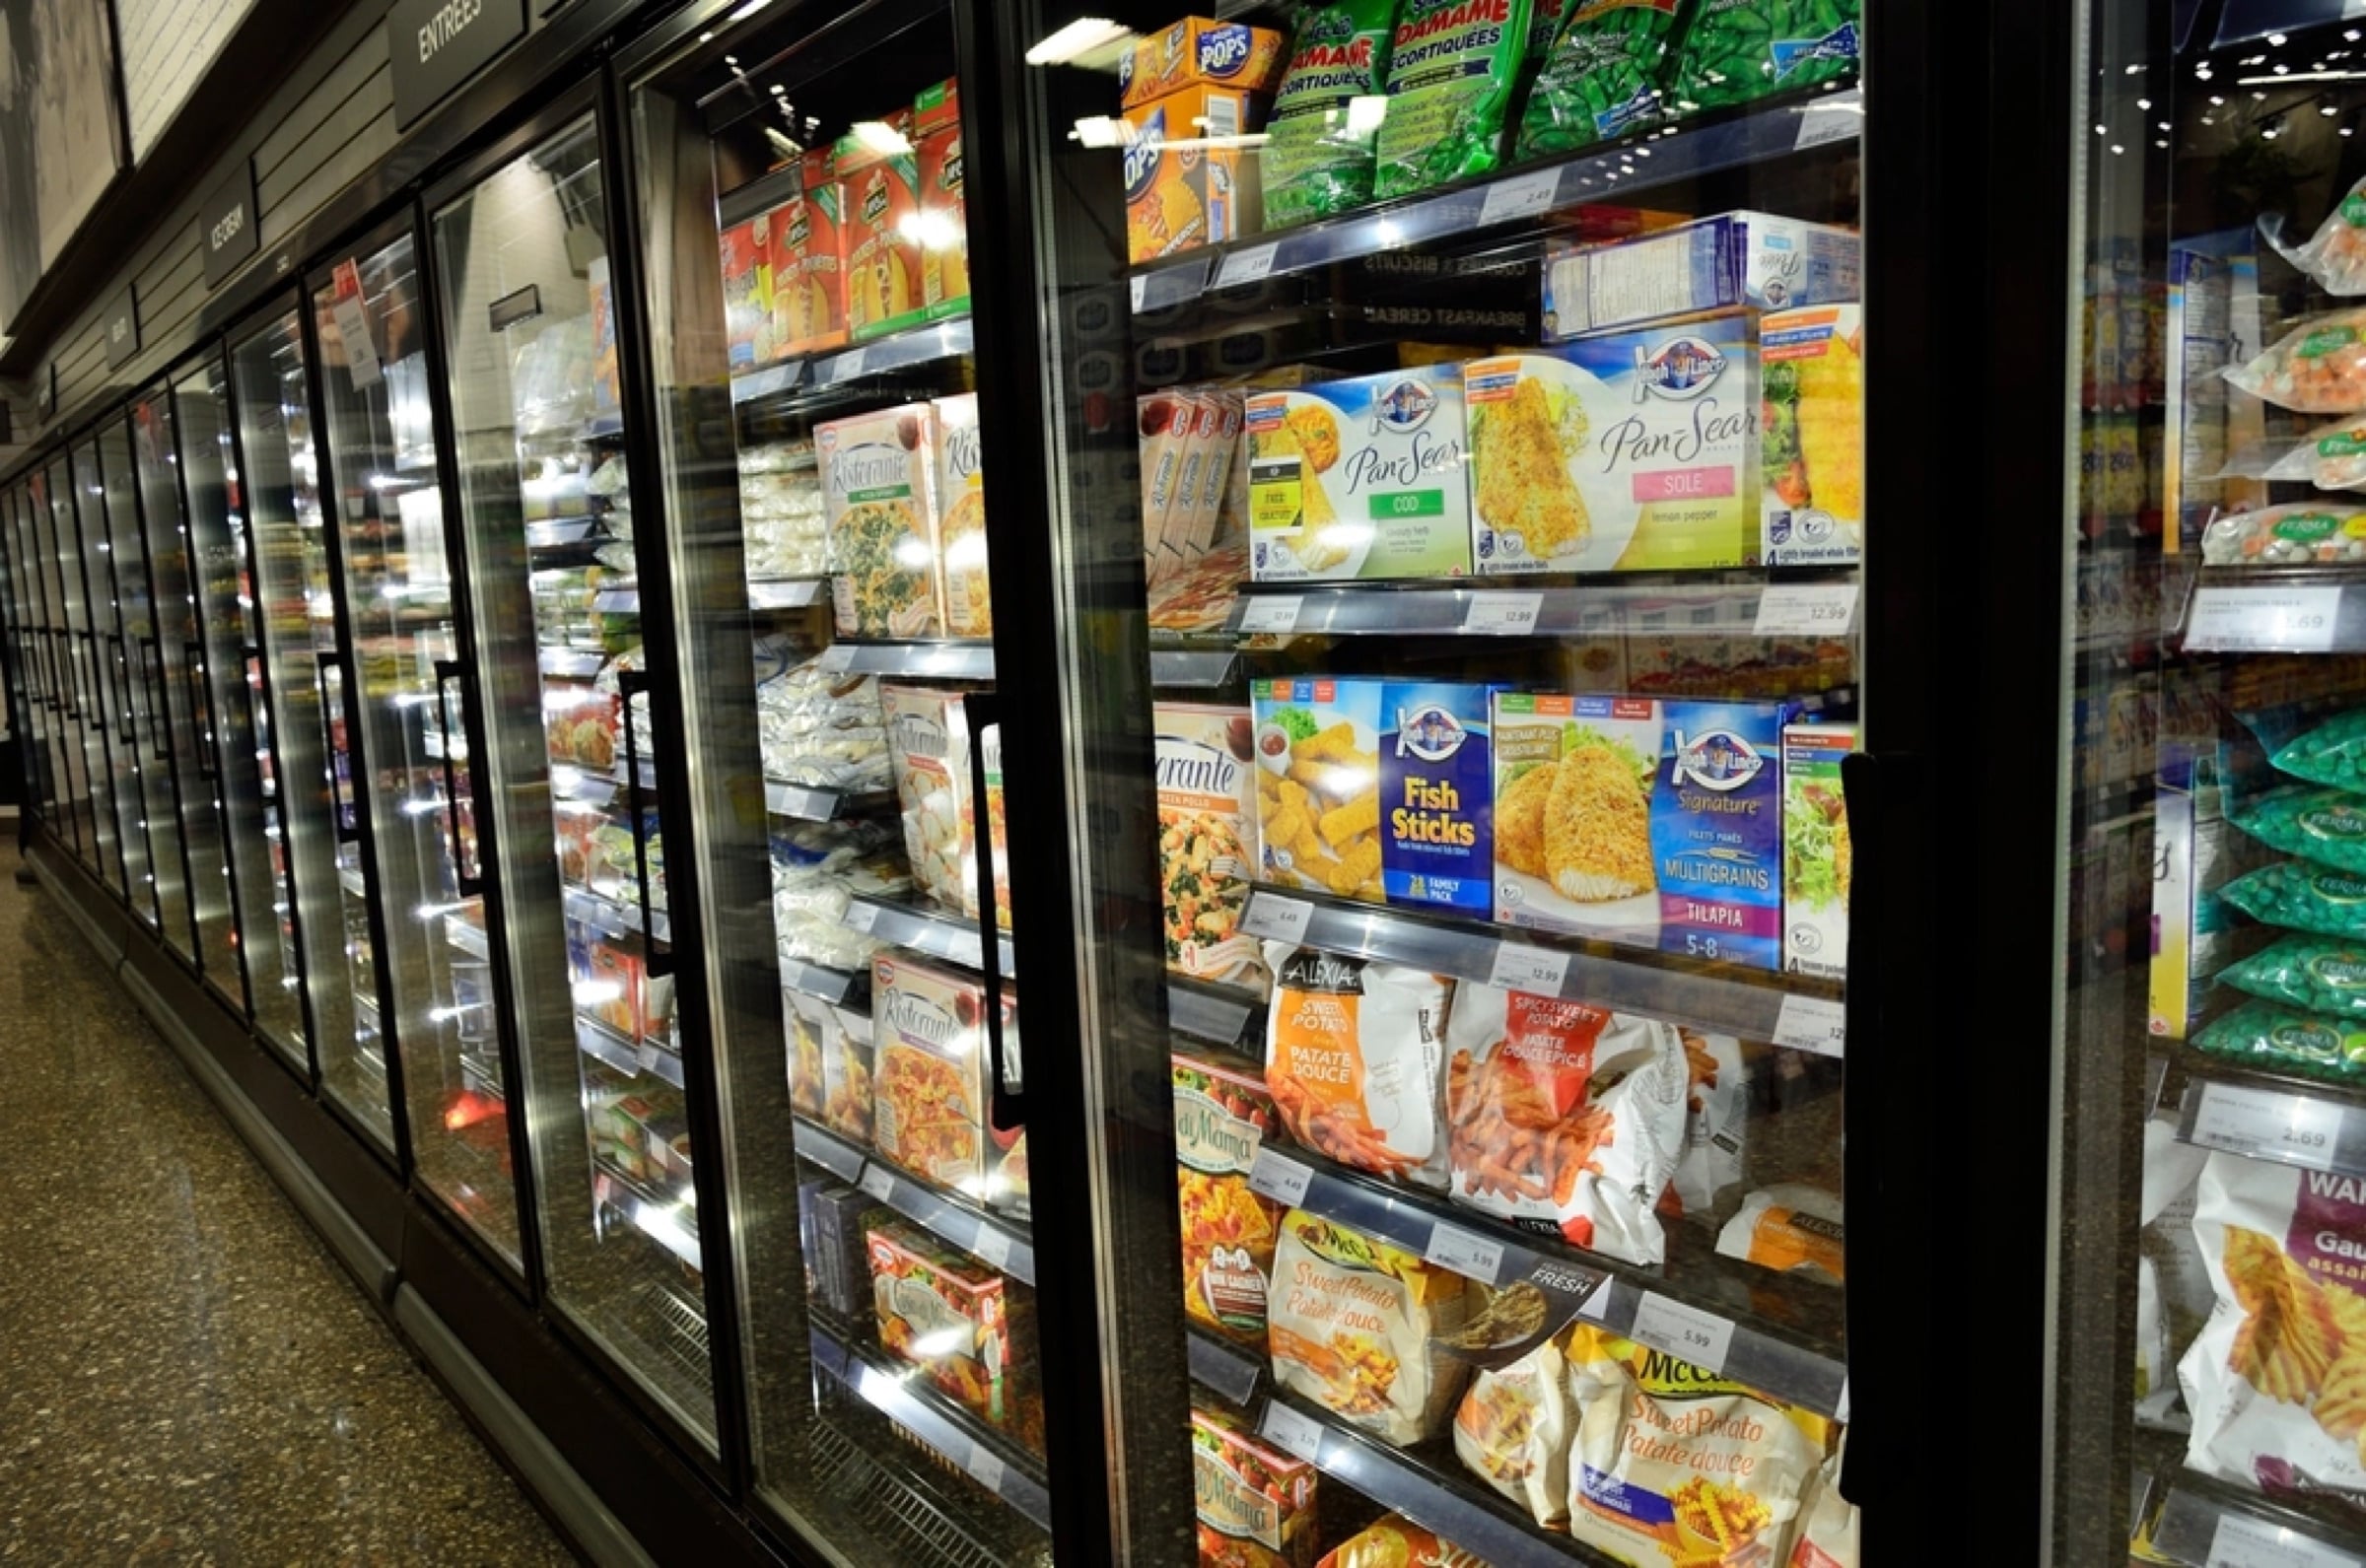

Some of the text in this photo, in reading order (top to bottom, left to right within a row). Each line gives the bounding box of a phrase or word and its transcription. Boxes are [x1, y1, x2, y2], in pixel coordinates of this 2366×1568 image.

[1201, 34, 1247, 72] POPS
[1600, 396, 1758, 474] Pan-Sear
[1663, 473, 1704, 494] SOLE
[1651, 509, 1717, 525] lemon pepper
[1811, 606, 1847, 621] 12.99
[1404, 776, 1460, 812] Fish
[1678, 789, 1757, 815] Signature
[1392, 807, 1476, 848] Sticks
[1665, 858, 1770, 891] MULTIGRAINS
[1687, 902, 1743, 926] TILAPIA
[1686, 934, 1718, 958] 5-8
[1285, 958, 1354, 986] ALEXIA
[1289, 1046, 1353, 1067] PATATE
[1293, 1063, 1351, 1084] DOUCE
[2282, 1126, 2327, 1146] 2.69
[1343, 1275, 1398, 1311] Potato
[1530, 1268, 1591, 1296] FRESH
[1684, 1330, 1711, 1347] 5.99
[1631, 1393, 1765, 1446] Sweet Potato
[1619, 1423, 1756, 1478] Patate douce
